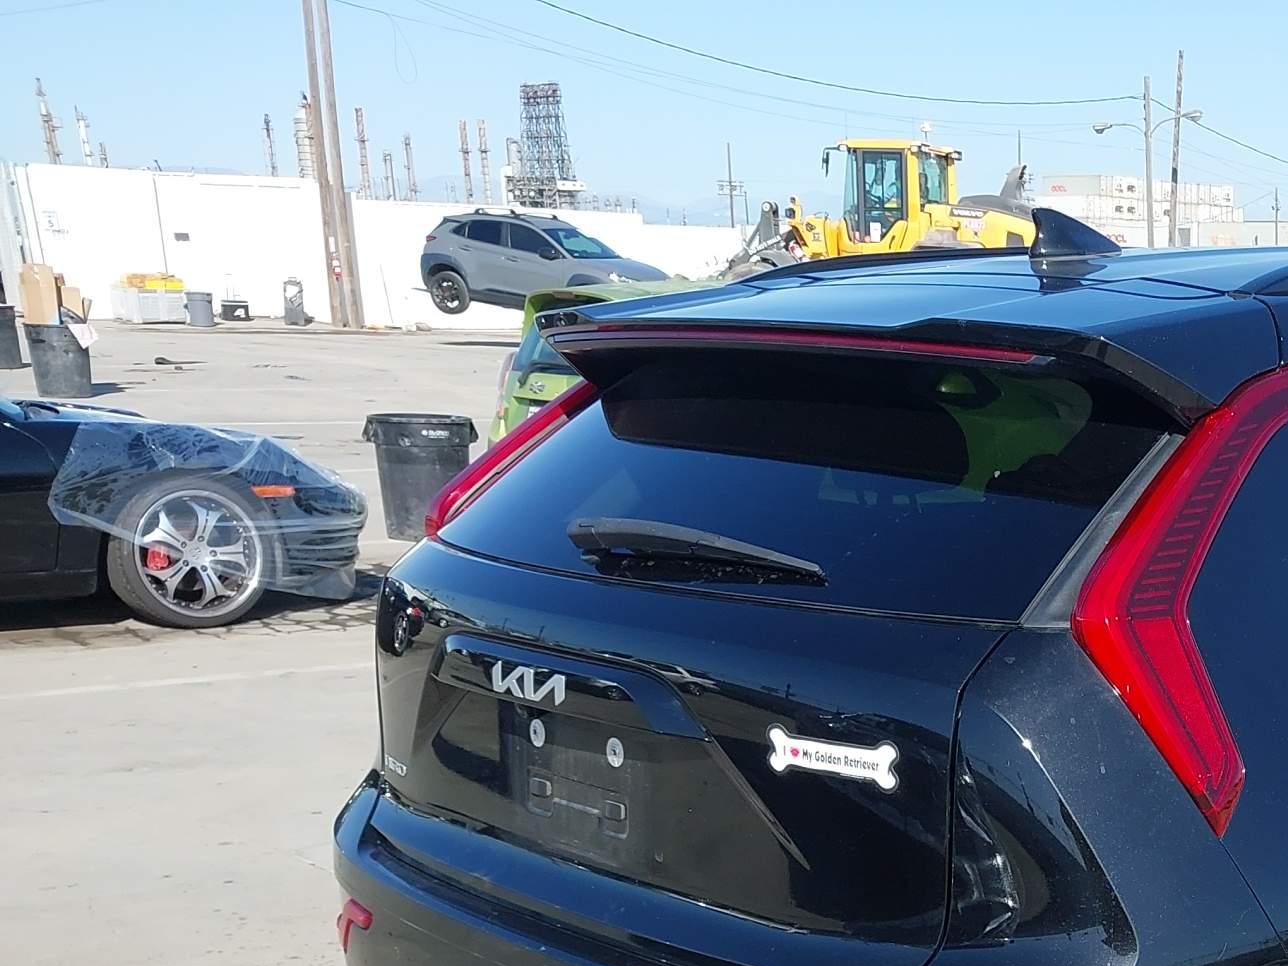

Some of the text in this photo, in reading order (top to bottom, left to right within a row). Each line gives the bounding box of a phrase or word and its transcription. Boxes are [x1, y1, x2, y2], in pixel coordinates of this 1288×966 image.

[492, 660, 566, 706] KIA
[802, 748, 812, 762] My
[815, 751, 841, 766] Golden
[844, 756, 880, 771] Retriever
